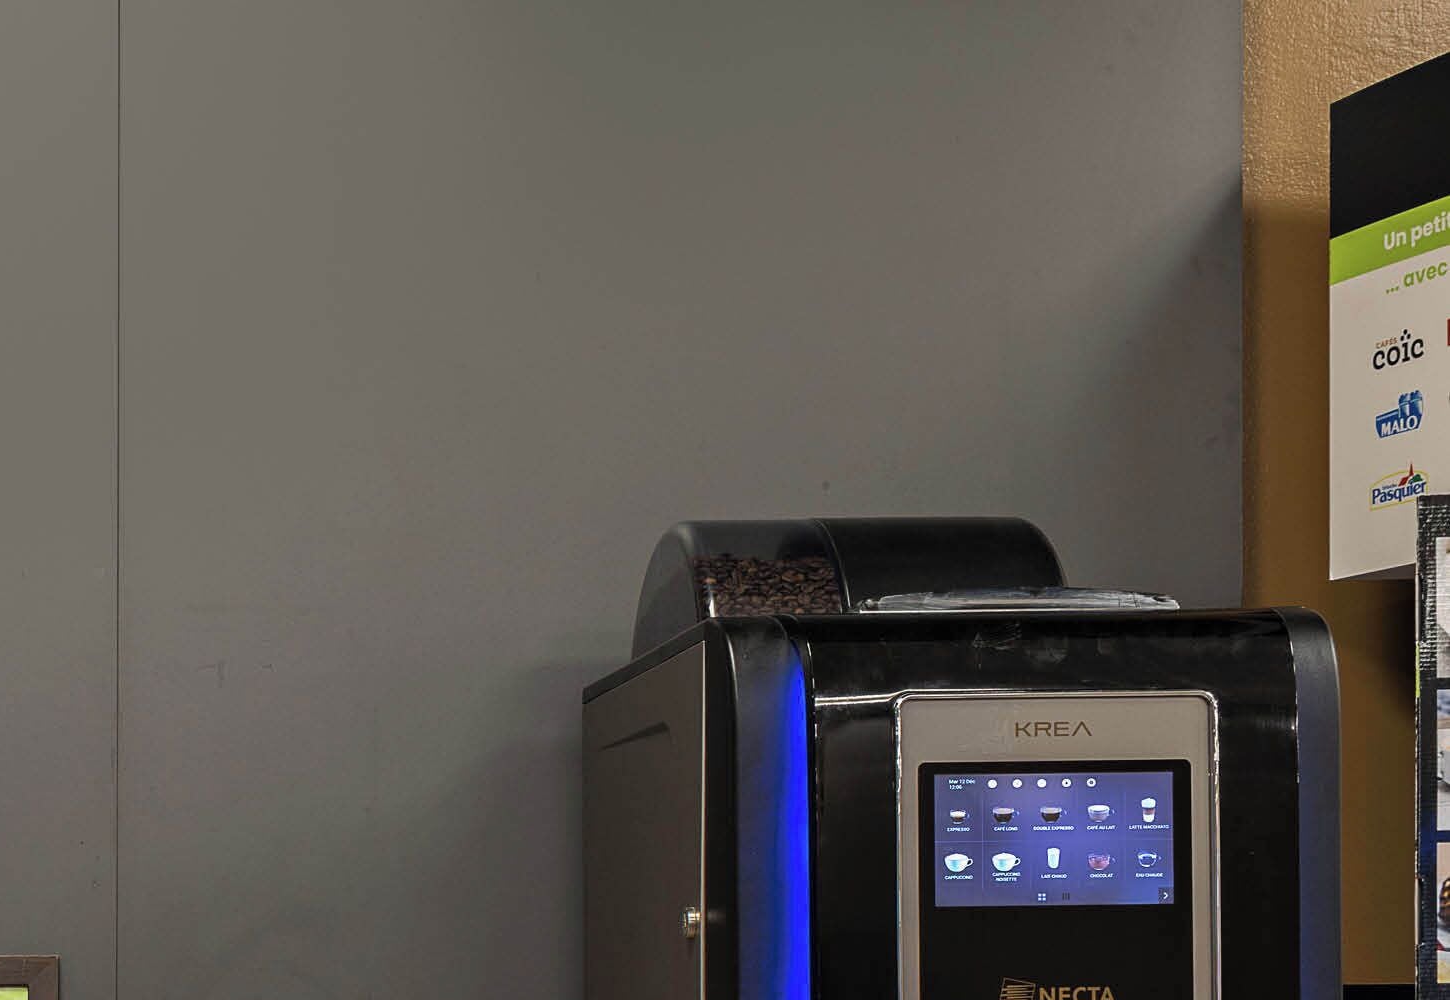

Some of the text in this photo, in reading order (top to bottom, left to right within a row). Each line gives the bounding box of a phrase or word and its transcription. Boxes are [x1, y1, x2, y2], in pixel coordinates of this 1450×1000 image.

[1383, 231, 1407, 250] Un
[1403, 262, 1447, 287] avec
[1381, 415, 1418, 437] MALO
[1372, 481, 1427, 504] Pasquier
[1015, 721, 1092, 737] KREA
